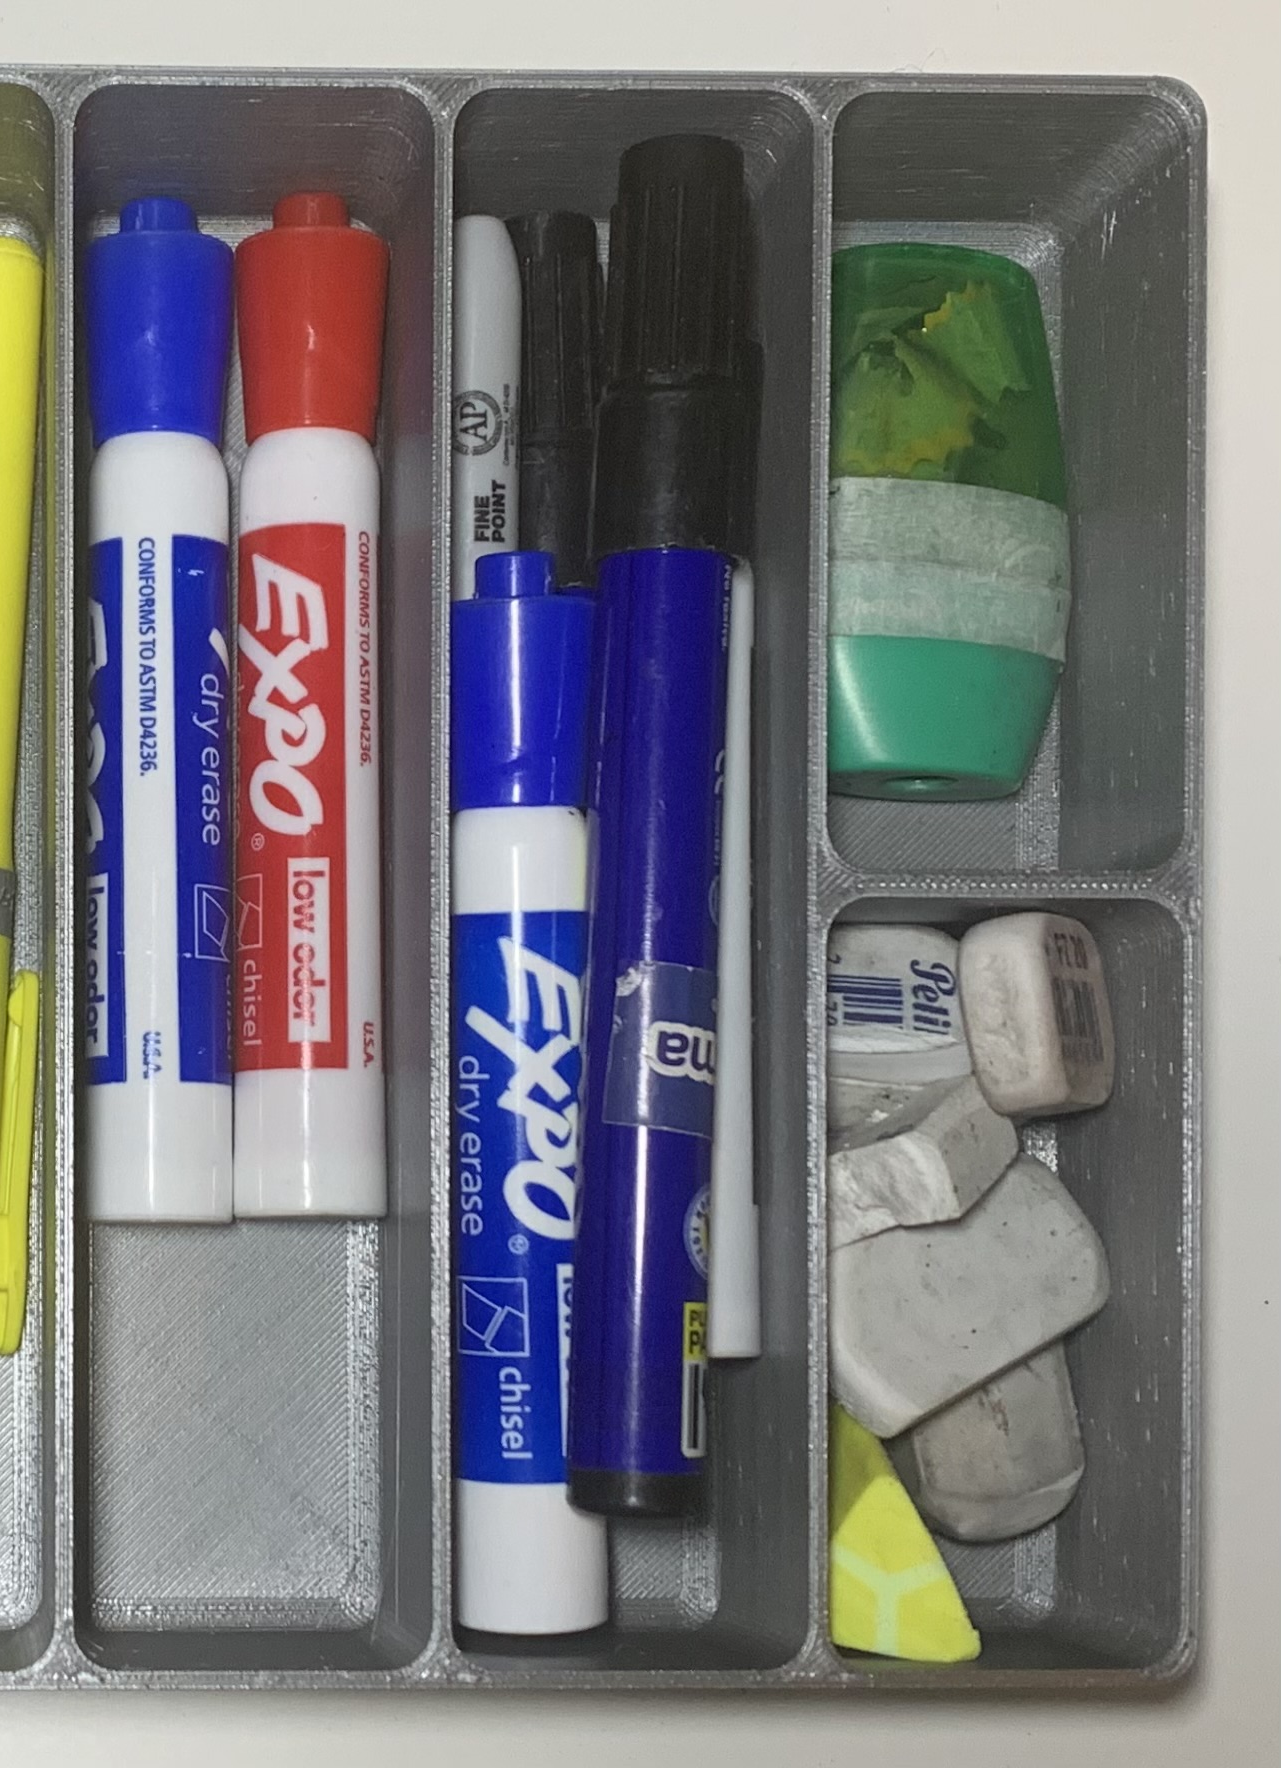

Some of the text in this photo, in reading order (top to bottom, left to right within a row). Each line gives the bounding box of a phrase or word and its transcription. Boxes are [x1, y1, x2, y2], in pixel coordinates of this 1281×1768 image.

[459, 401, 489, 442] AP
[473, 495, 491, 543] FINE
[491, 479, 506, 543] POINT
[138, 536, 158, 777] CONFORMS TO ASTM D4236.
[239, 554, 329, 835] EXPO
[358, 530, 372, 767] CONFORMS TO ASTM D4236.
[191, 673, 225, 846] dry erase
[242, 958, 262, 1047] chisel
[292, 869, 326, 1028] low odor
[910, 960, 957, 1036] Peli
[363, 1021, 375, 1069] U.S.A.
[465, 937, 582, 1240] EXPO
[454, 1055, 490, 1235] dry erase
[499, 1366, 533, 1460] chisel
